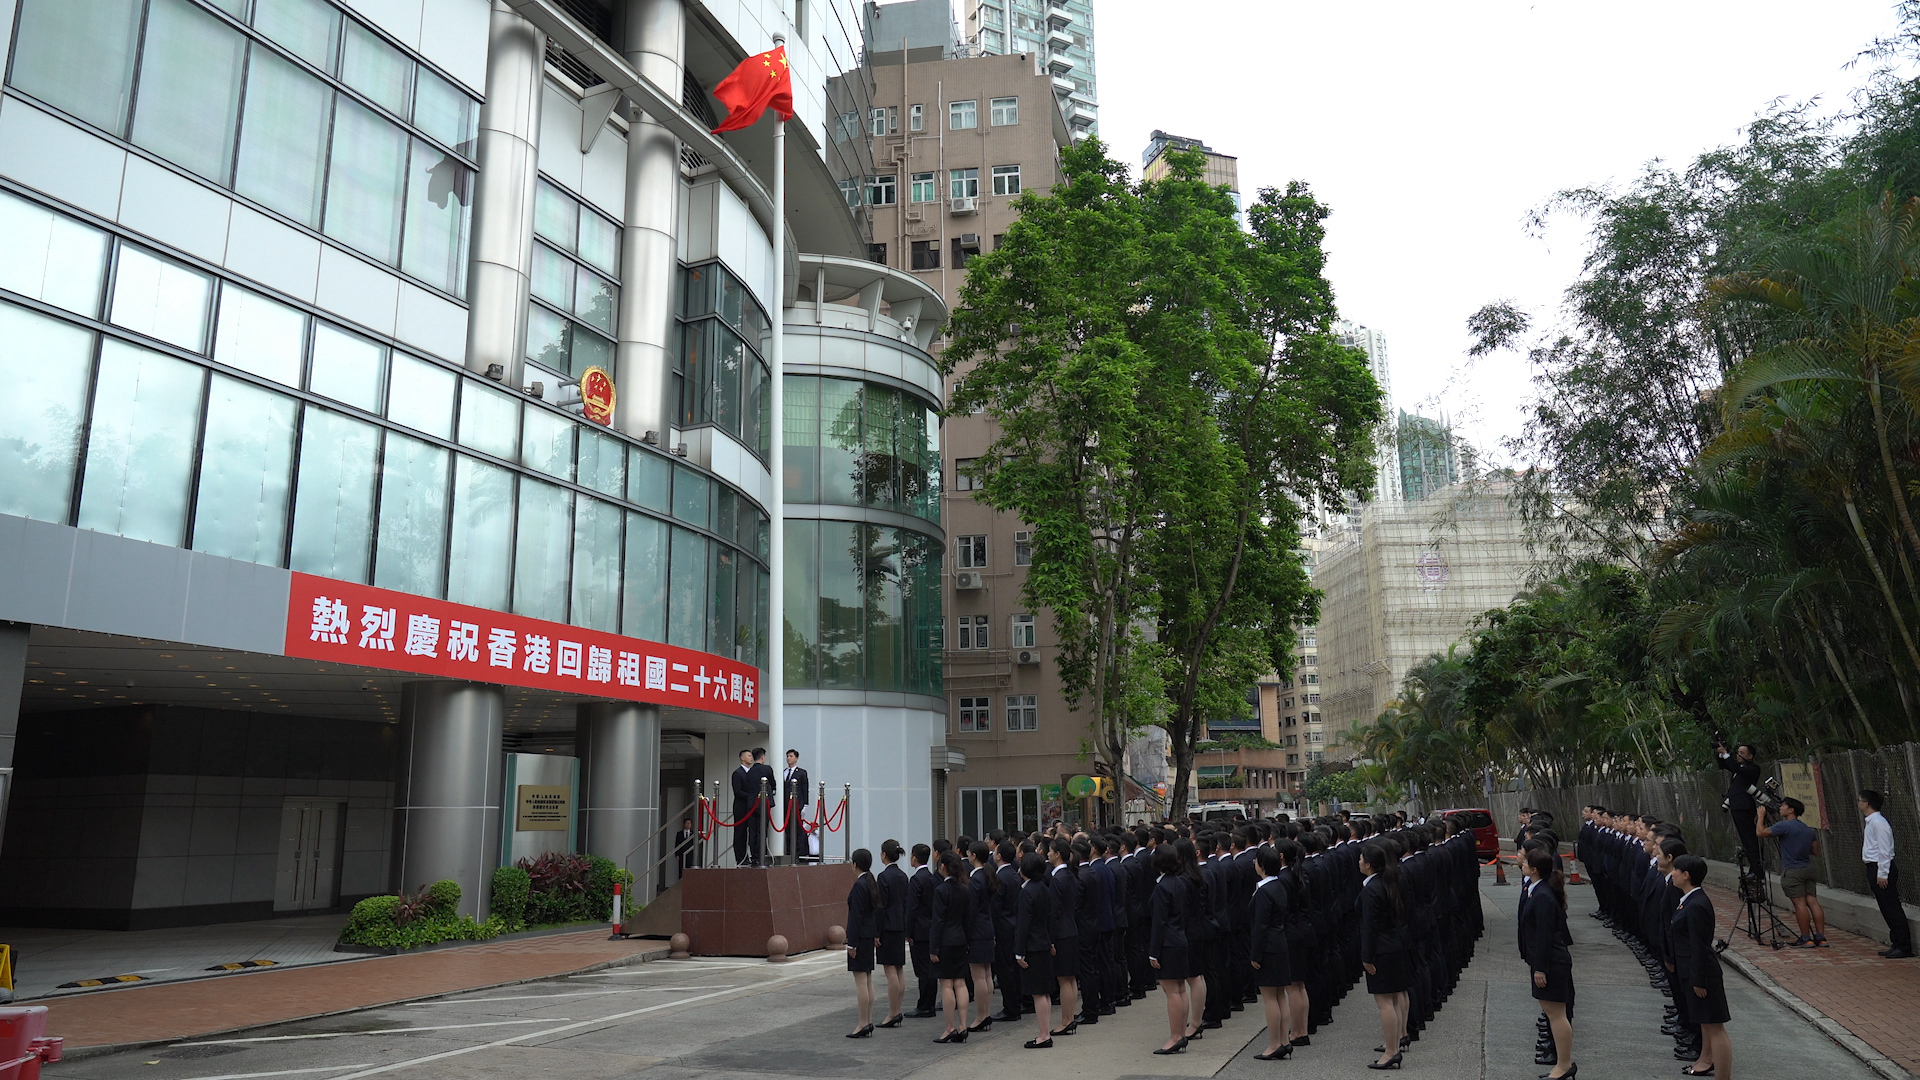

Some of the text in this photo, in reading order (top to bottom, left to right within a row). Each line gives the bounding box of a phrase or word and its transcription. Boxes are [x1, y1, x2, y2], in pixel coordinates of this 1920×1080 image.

[309, 595, 756, 708] 熱烈慶祝香港回歸祖國二十六周年
